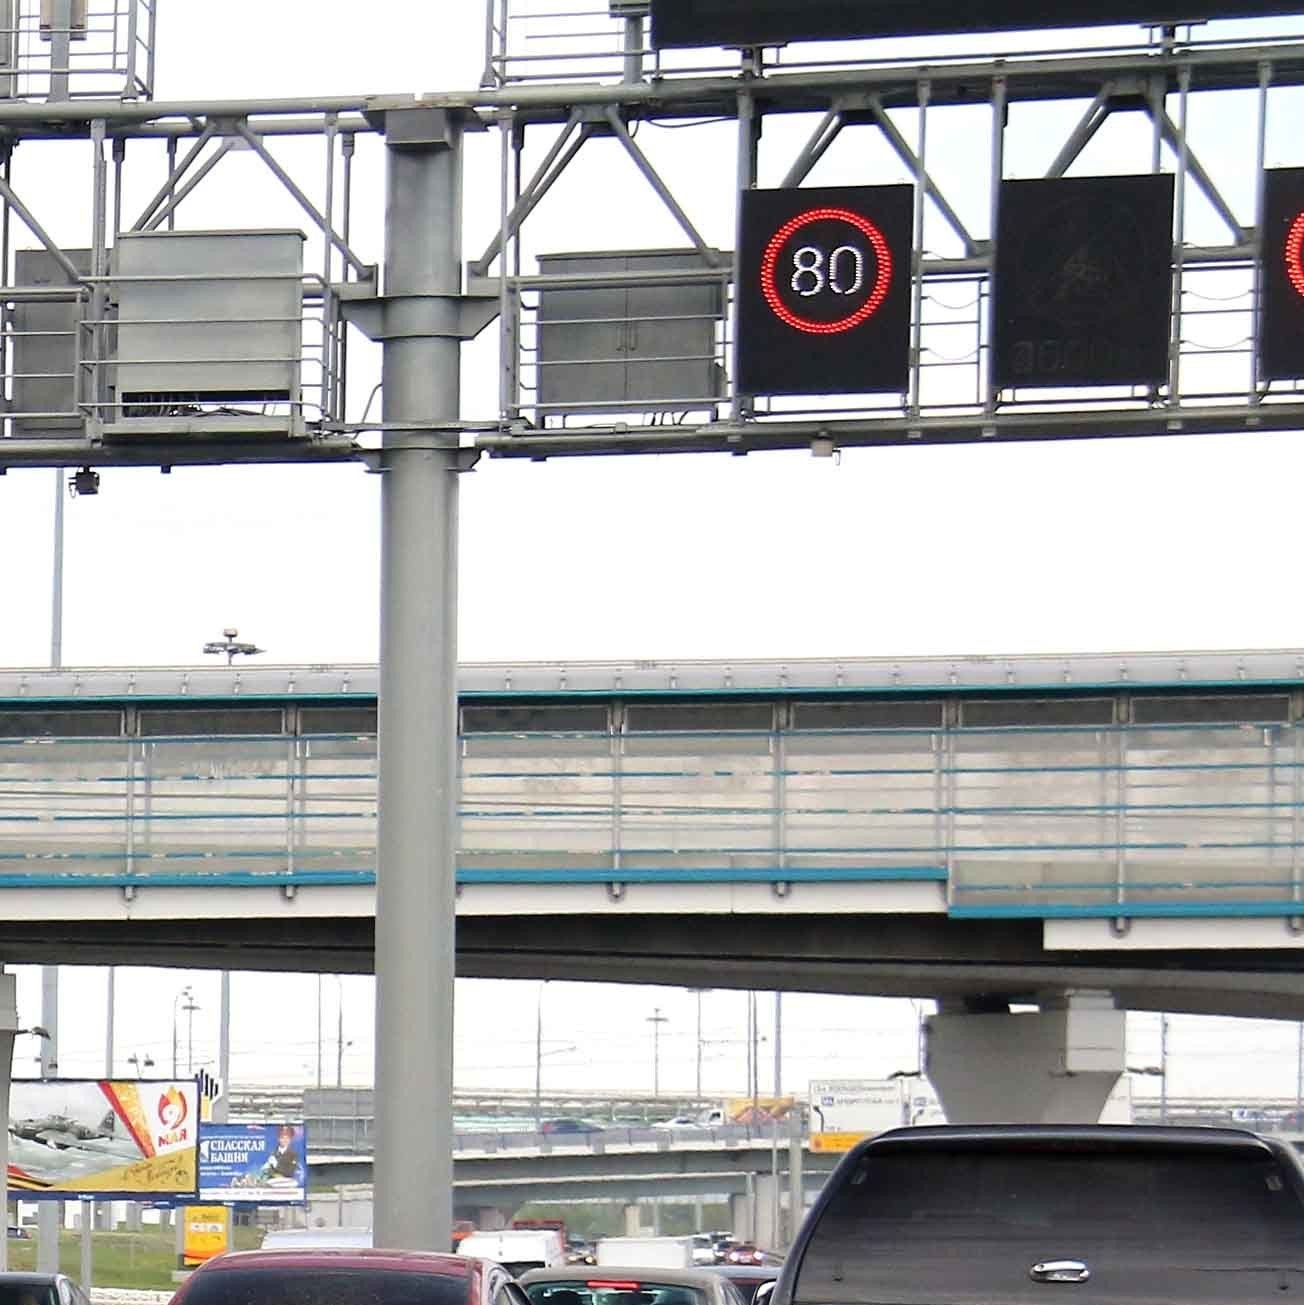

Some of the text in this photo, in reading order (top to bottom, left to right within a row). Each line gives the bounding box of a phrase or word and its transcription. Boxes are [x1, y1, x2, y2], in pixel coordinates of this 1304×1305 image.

[791, 246, 863, 296] 80
[158, 1128, 188, 1148] МАЯ
[210, 1140, 265, 1152] СПАССКАЯ
